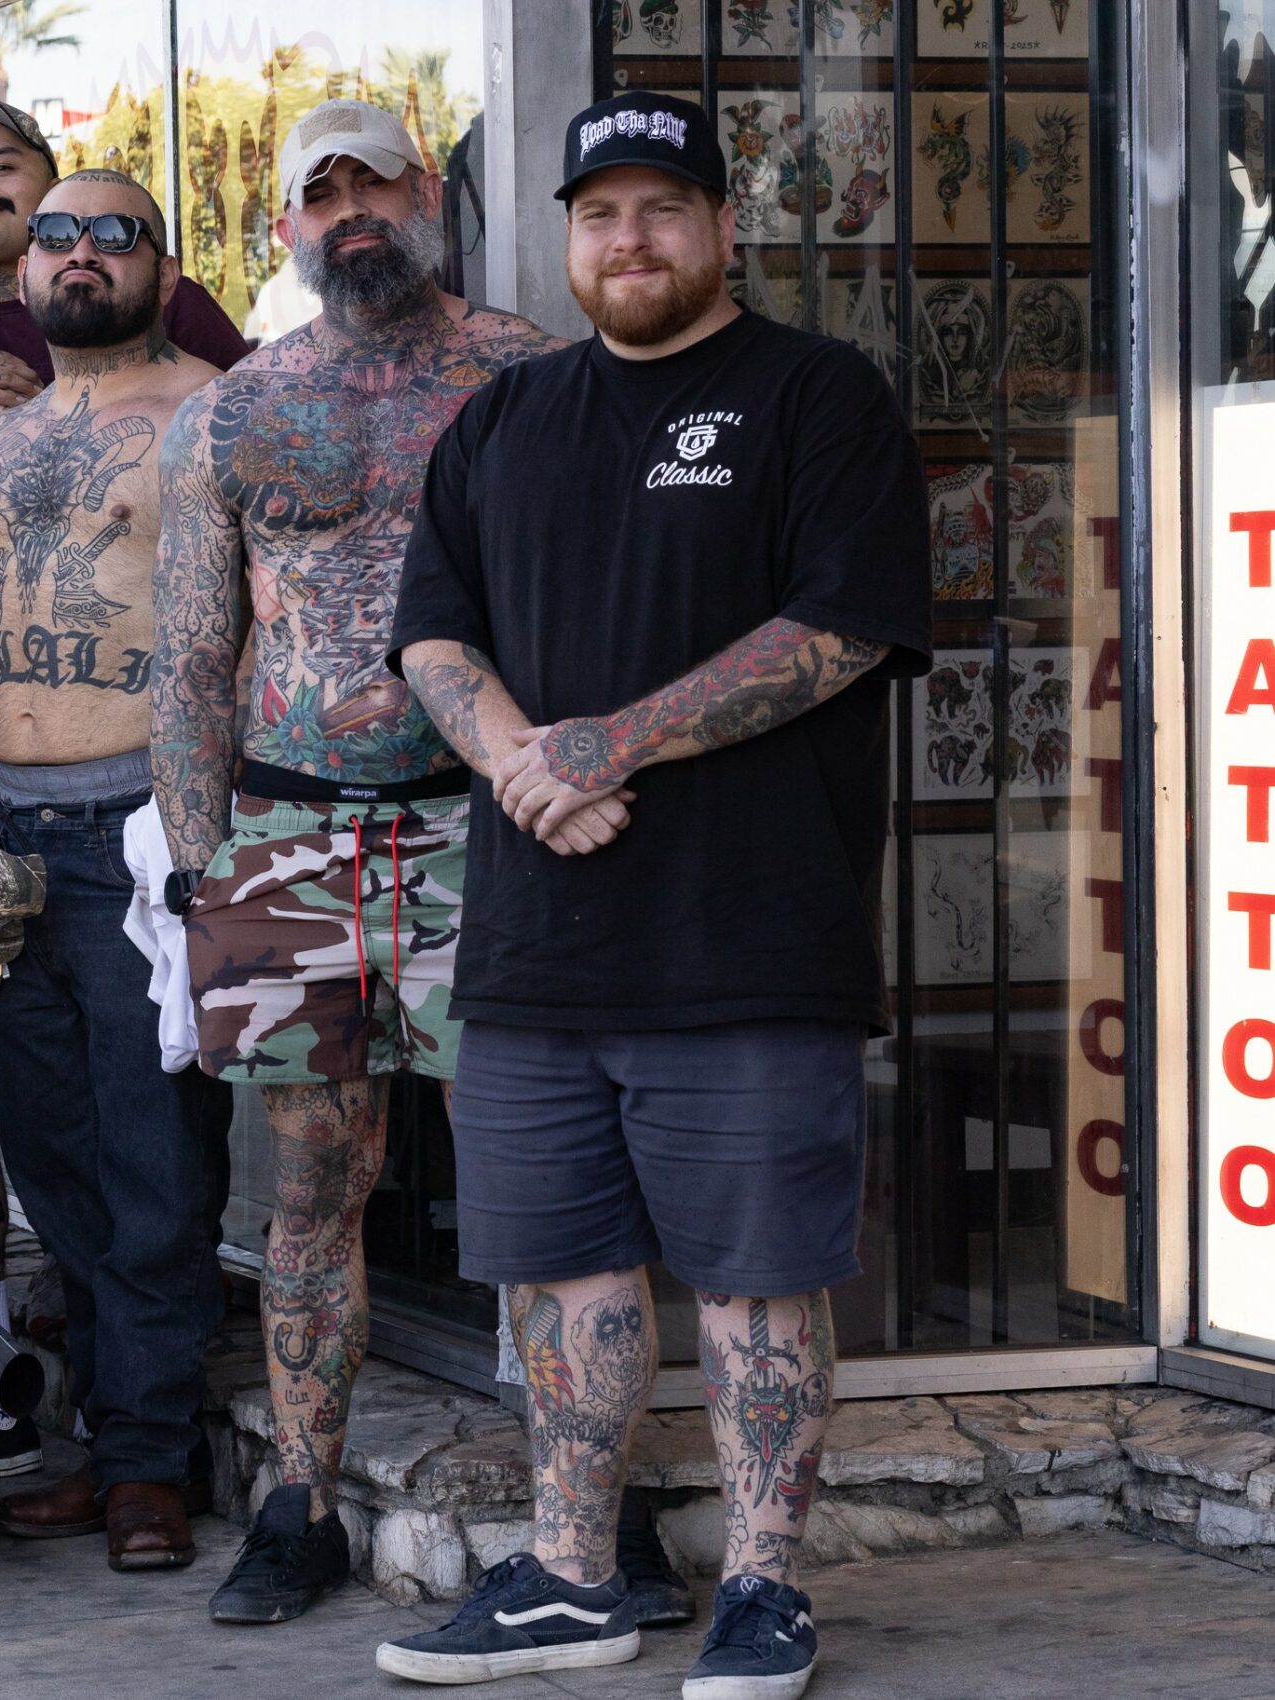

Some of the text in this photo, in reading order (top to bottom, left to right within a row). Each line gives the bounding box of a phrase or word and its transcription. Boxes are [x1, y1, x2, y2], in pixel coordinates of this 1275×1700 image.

[667, 411, 744, 433] ORIGINAL
[646, 460, 733, 489] Classic
[1219, 510, 1275, 1226] TATTOO
